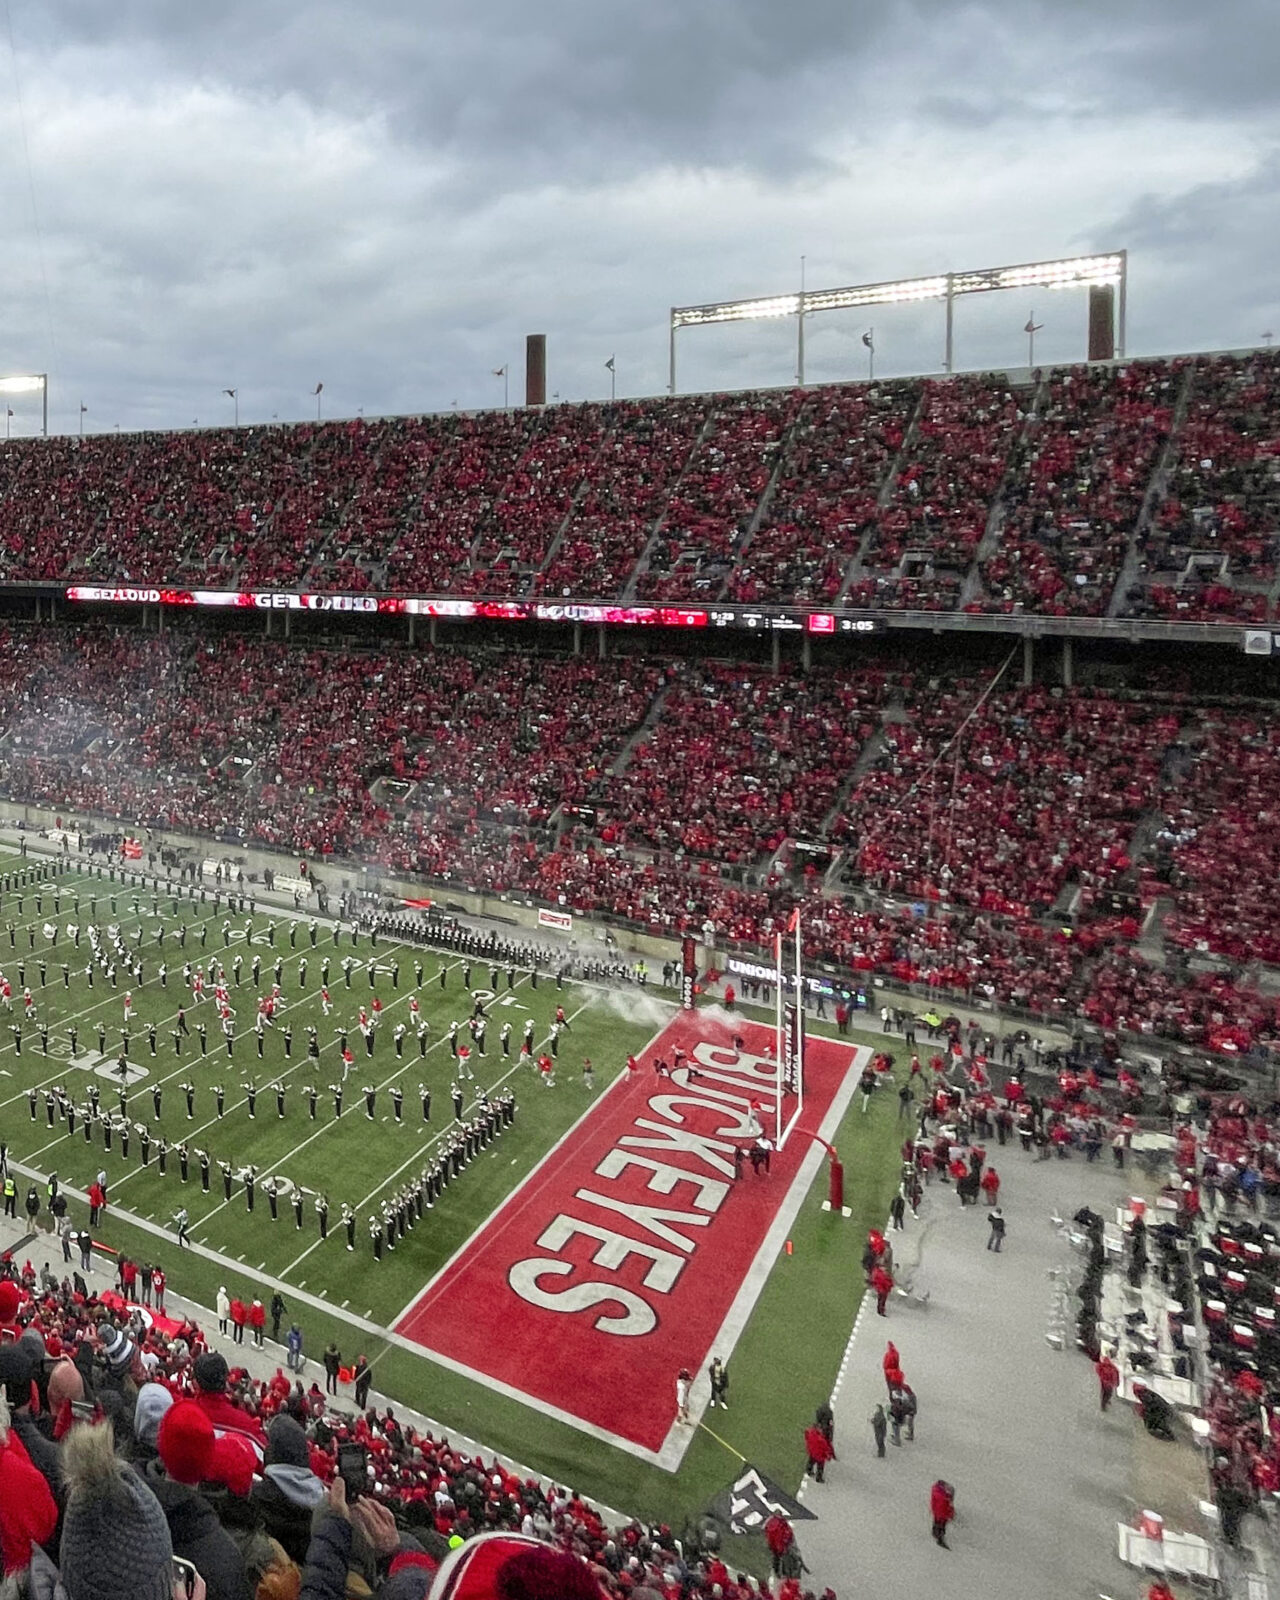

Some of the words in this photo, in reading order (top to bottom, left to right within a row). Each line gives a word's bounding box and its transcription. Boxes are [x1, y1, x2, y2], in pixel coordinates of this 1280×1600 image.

[118, 588, 161, 602] LOUD
[841, 619, 874, 631] 3:05
[729, 960, 780, 981] UNION
[507, 1041, 787, 1337] BUCKEYES
